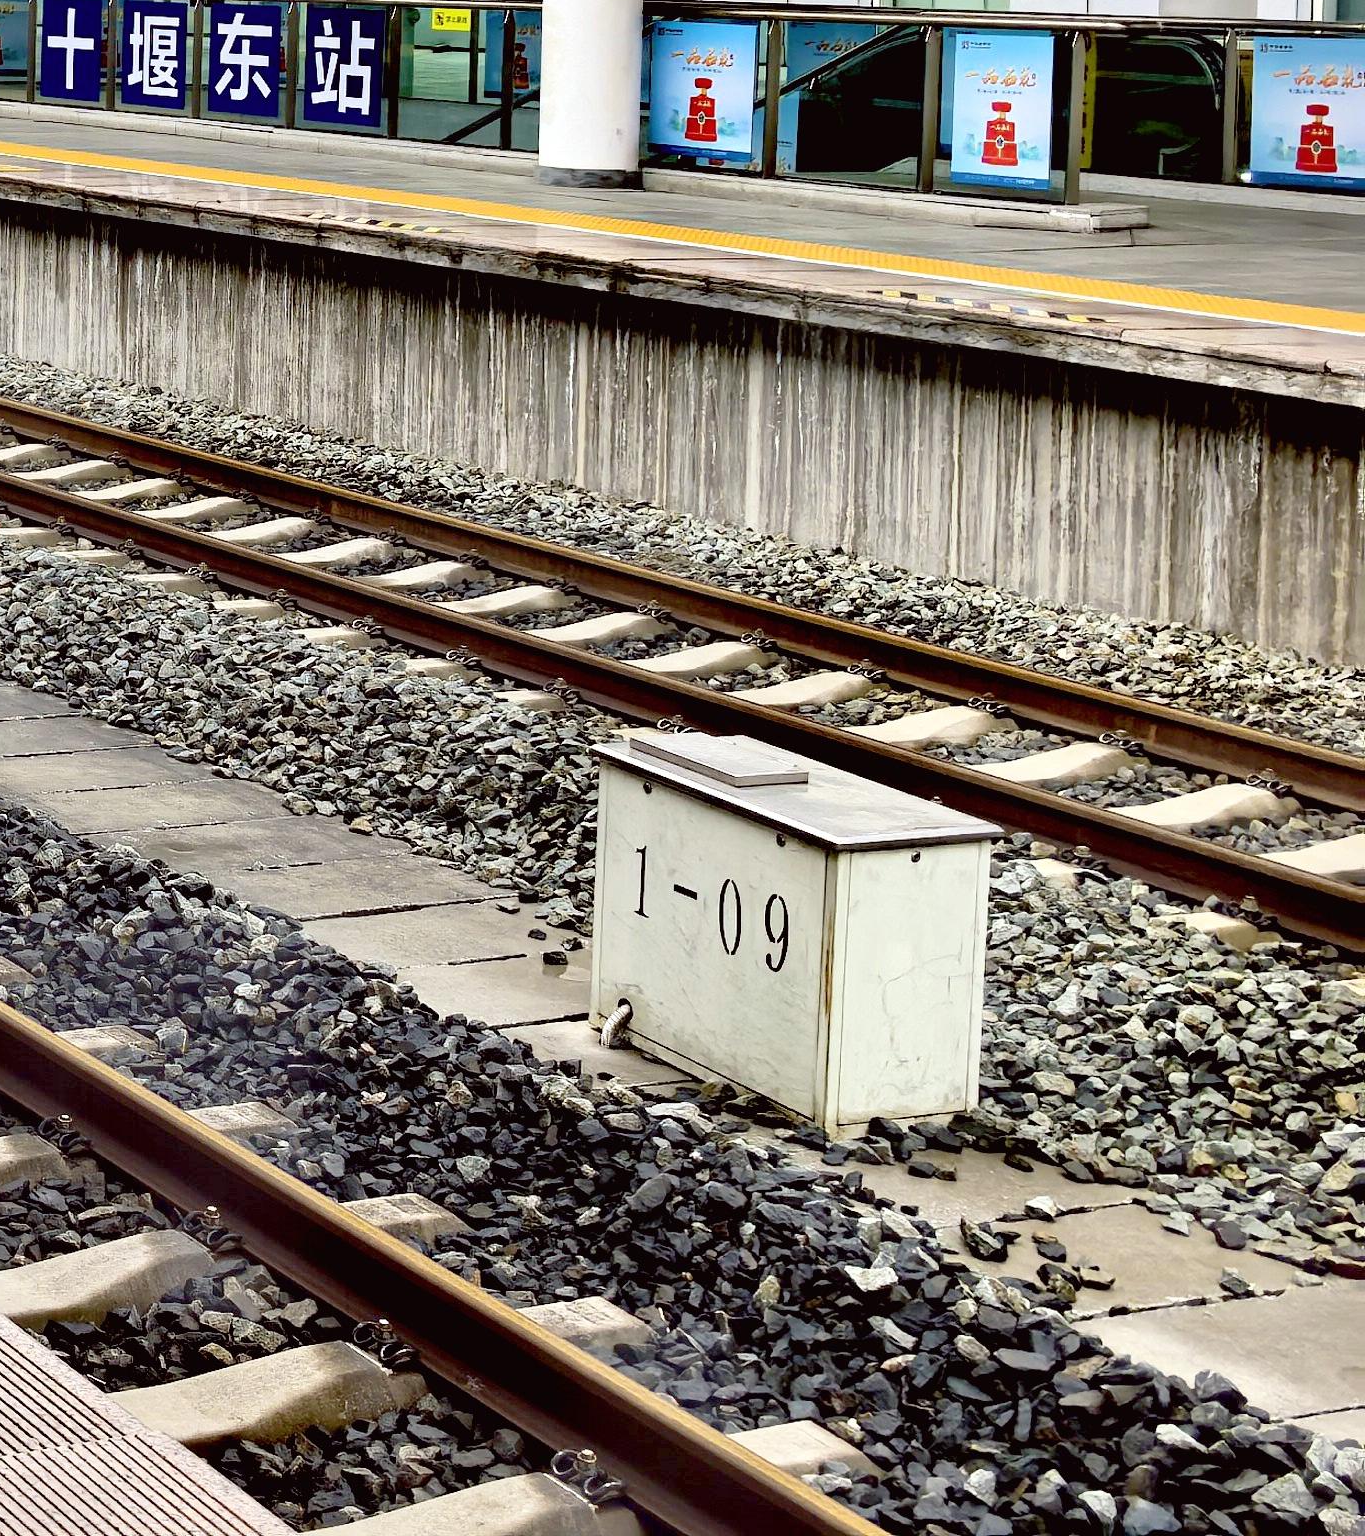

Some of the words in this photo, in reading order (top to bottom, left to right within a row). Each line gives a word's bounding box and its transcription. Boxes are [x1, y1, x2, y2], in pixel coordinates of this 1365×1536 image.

[47, 8, 375, 115] 十堰东站
[634, 845, 789, 973] 1-09
